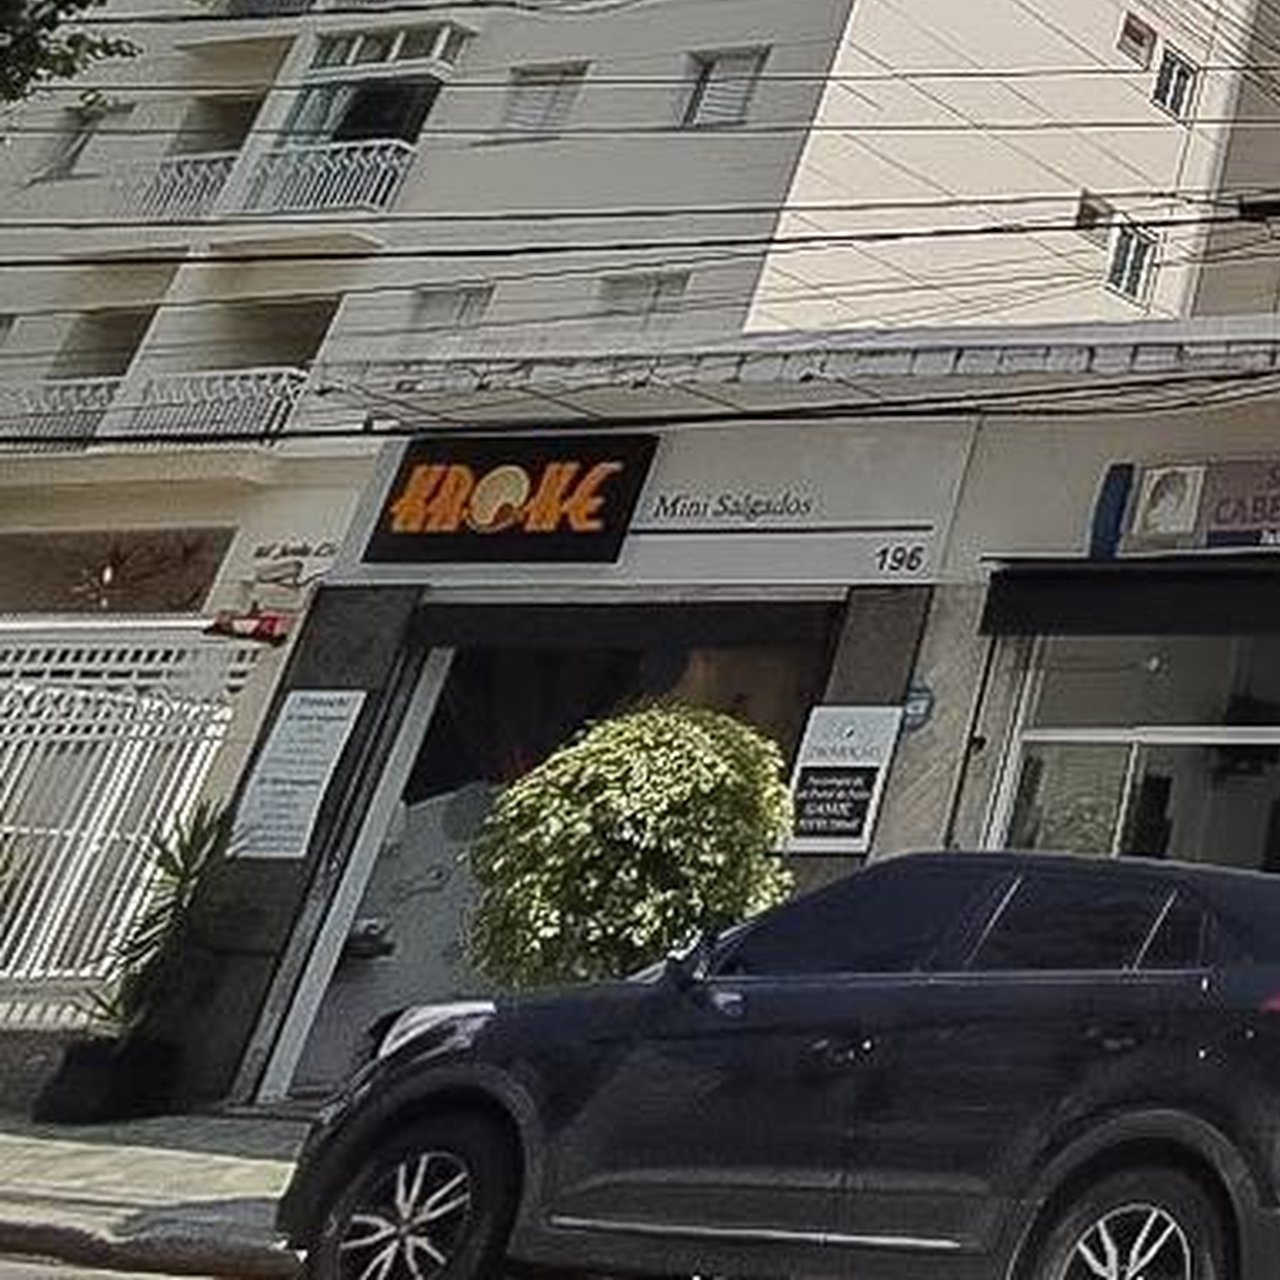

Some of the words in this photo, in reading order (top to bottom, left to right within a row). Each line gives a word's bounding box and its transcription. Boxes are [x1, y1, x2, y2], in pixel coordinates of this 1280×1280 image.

[653, 494, 709, 518] Mini
[711, 490, 813, 521] Salgados
[875, 543, 925, 571] 196
